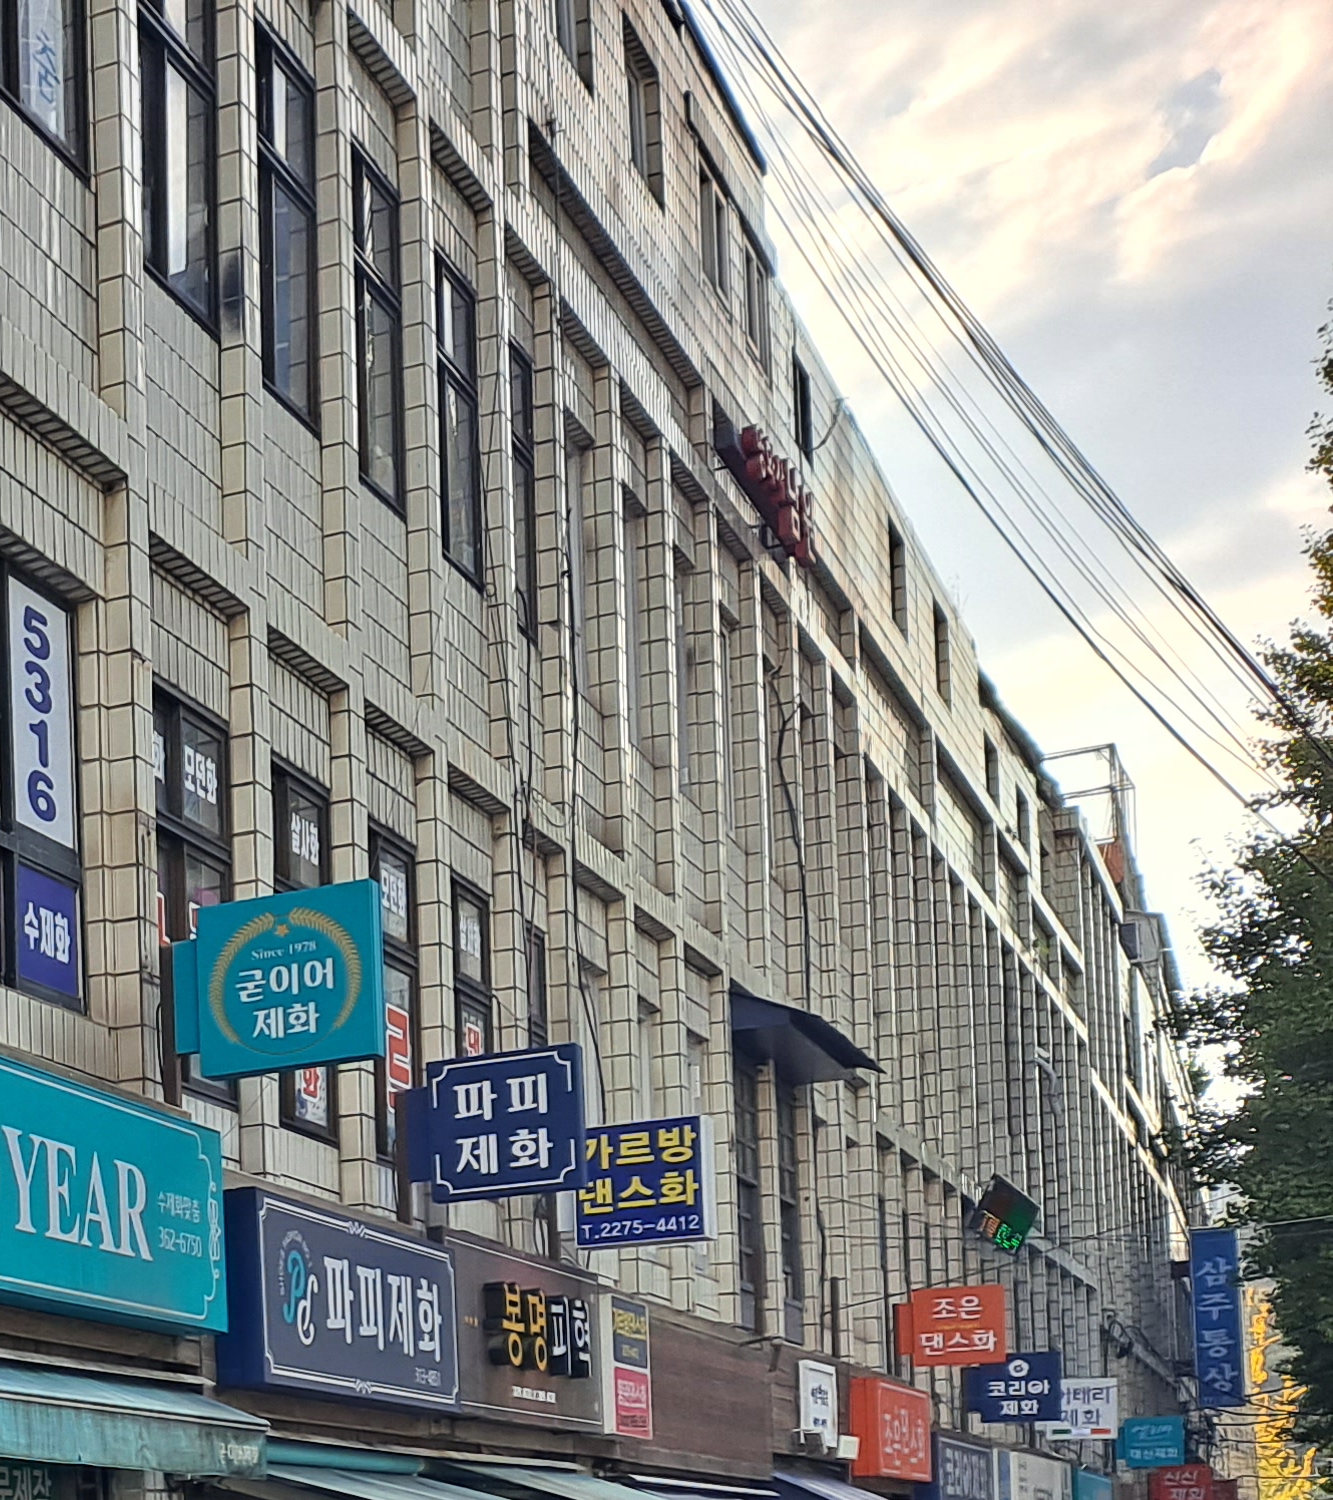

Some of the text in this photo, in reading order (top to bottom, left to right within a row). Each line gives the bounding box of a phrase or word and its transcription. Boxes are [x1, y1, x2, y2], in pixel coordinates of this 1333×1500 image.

[22, 606, 57, 822] 5316
[24, 901, 71, 964] 수제화
[251, 940, 317, 961] Since 1978
[235, 957, 334, 1003] 굳이어
[252, 1001, 319, 1040] 제화
[452, 1073, 548, 1121] 파피
[455, 1128, 553, 1175] 제화
[586, 1125, 697, 1170] 가르방
[1, 1125, 153, 1263] YEAR
[579, 1170, 700, 1214] 댄스화
[581, 1216, 700, 1240] T.2275-4412
[323, 1256, 443, 1363] 파피제화
[932, 1295, 983, 1319] 조은
[920, 1329, 997, 1356] 댄스화
[988, 1380, 1050, 1398] 코리아
[1000, 1400, 1039, 1415] 제화
